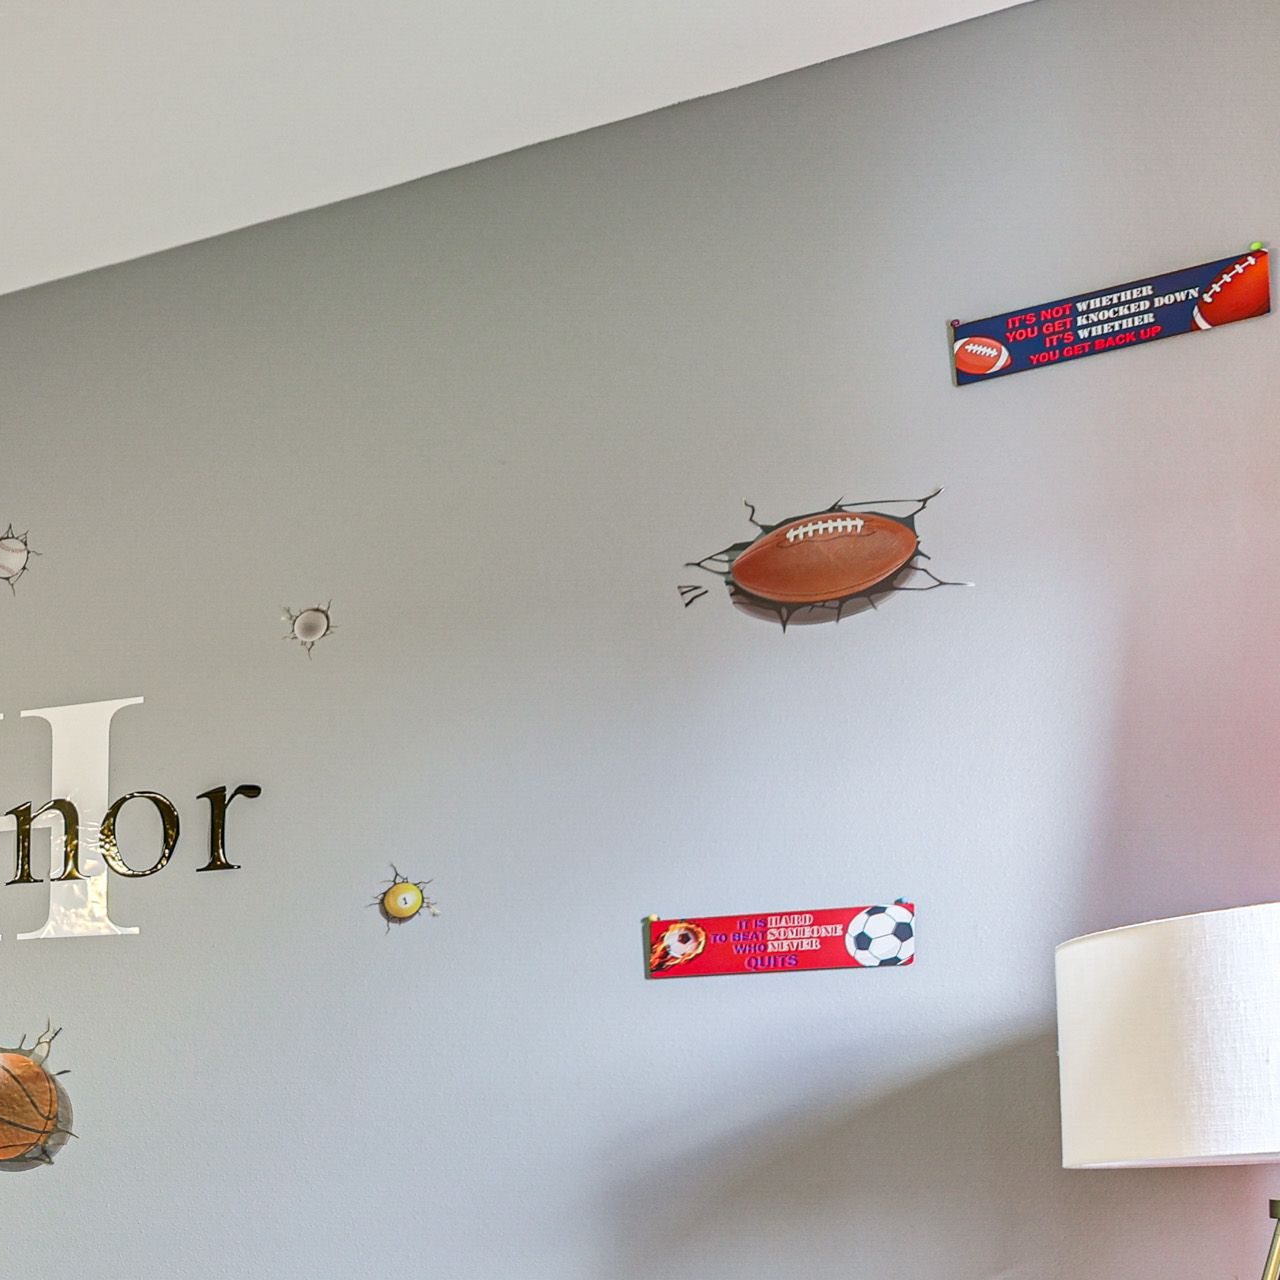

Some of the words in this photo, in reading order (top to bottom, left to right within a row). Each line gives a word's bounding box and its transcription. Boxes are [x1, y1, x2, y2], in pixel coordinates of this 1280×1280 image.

[1005, 326, 1038, 344] YOU
[1042, 317, 1073, 335] GET
[1076, 301, 1151, 327] KNOCKED
[1153, 287, 1201, 308] DOWN
[1006, 312, 1037, 330] IT'S
[1040, 303, 1073, 322] NOT
[1075, 284, 1154, 313] WHETHER
[1044, 331, 1075, 348] IT'S
[1077, 312, 1156, 340] WHETHER
[1029, 348, 1060, 366] YOU
[1062, 340, 1092, 358] GET
[1093, 330, 1137, 350] BACK
[1139, 325, 1163, 340] UP
[710, 933, 728, 944] TO
[731, 930, 768, 942] BEAT
[767, 924, 843, 940] SOMEONE
[736, 919, 749, 930] IT
[753, 919, 767, 929] IS
[767, 913, 814, 928] HARD
[733, 943, 767, 954] WHO
[767, 938, 821, 953] NEVER
[744, 953, 799, 971] QUITS
